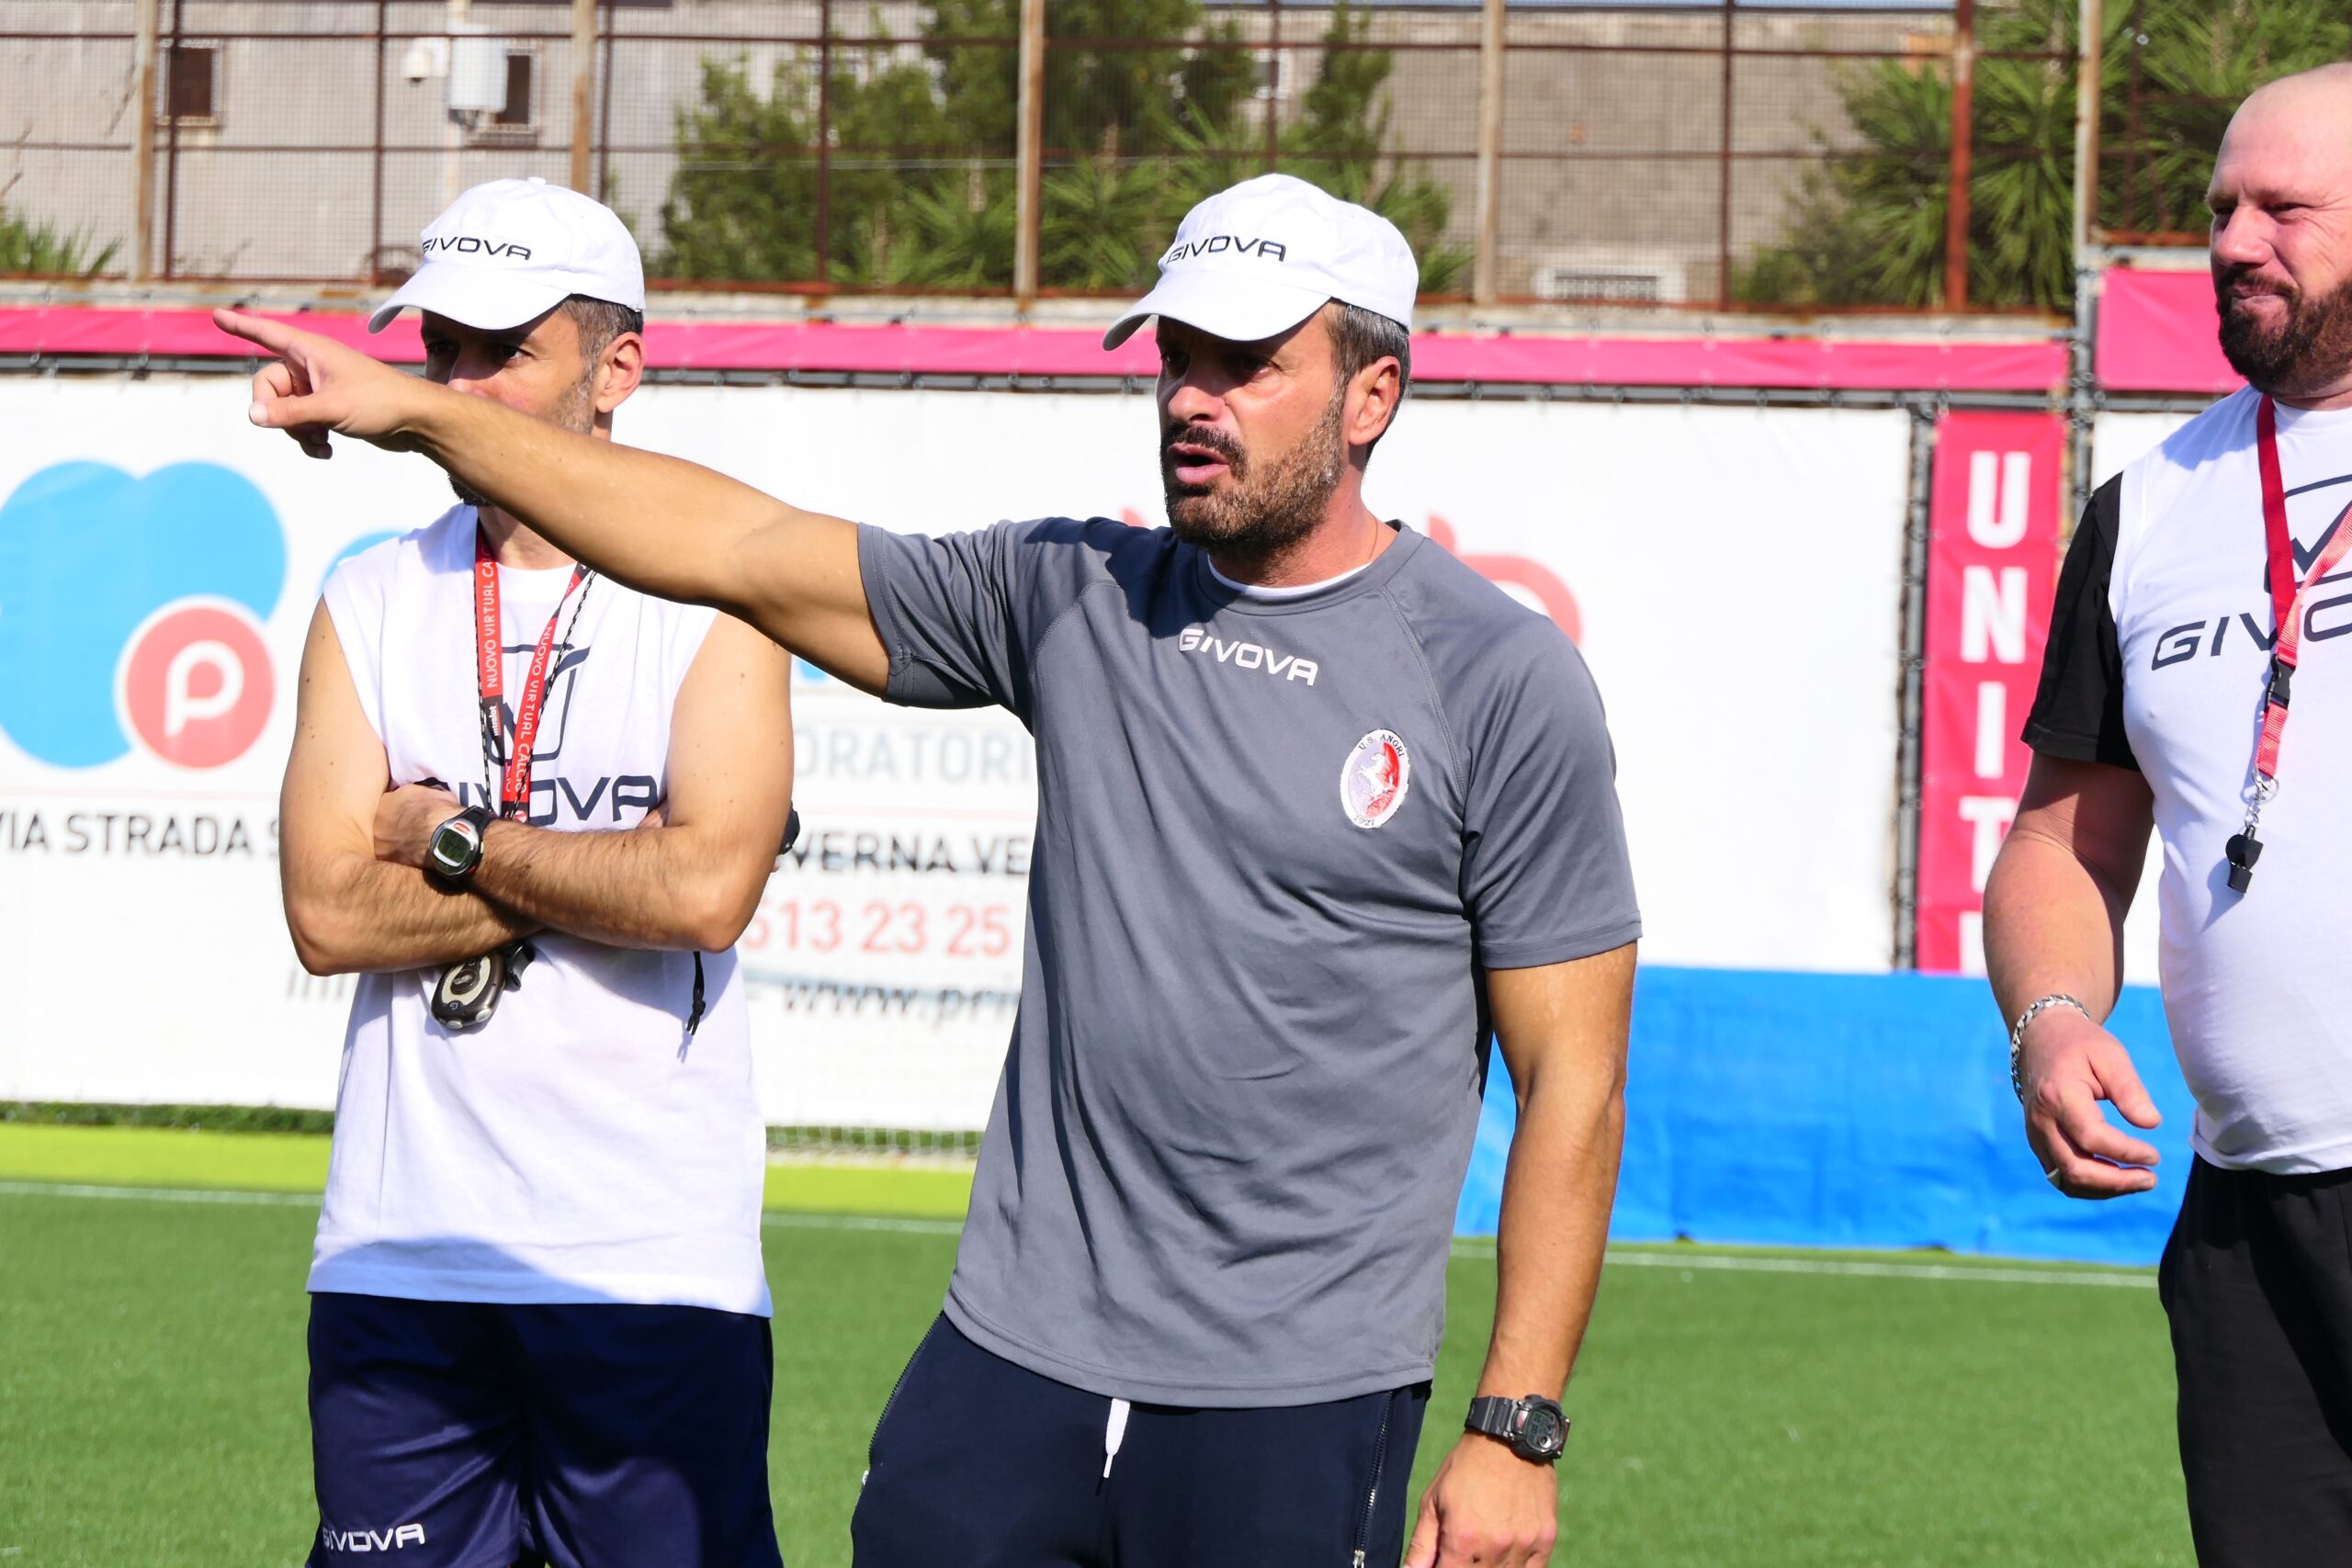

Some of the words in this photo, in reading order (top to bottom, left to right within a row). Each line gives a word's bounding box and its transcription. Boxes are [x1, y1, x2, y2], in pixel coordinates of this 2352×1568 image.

[1166, 234, 1287, 263] GIVOVA
[482, 581, 496, 637] VIRTUAL
[484, 639, 498, 689] NUOVO
[532, 626, 553, 677] NUOVO
[1179, 628, 1319, 687] GIVOVA
[520, 680, 540, 740] VIRTUAL
[67, 812, 254, 856] STRADA
[860, 899, 930, 955] 23
[944, 903, 1013, 958] 25
[322, 1522, 426, 1553] GIVOVA
